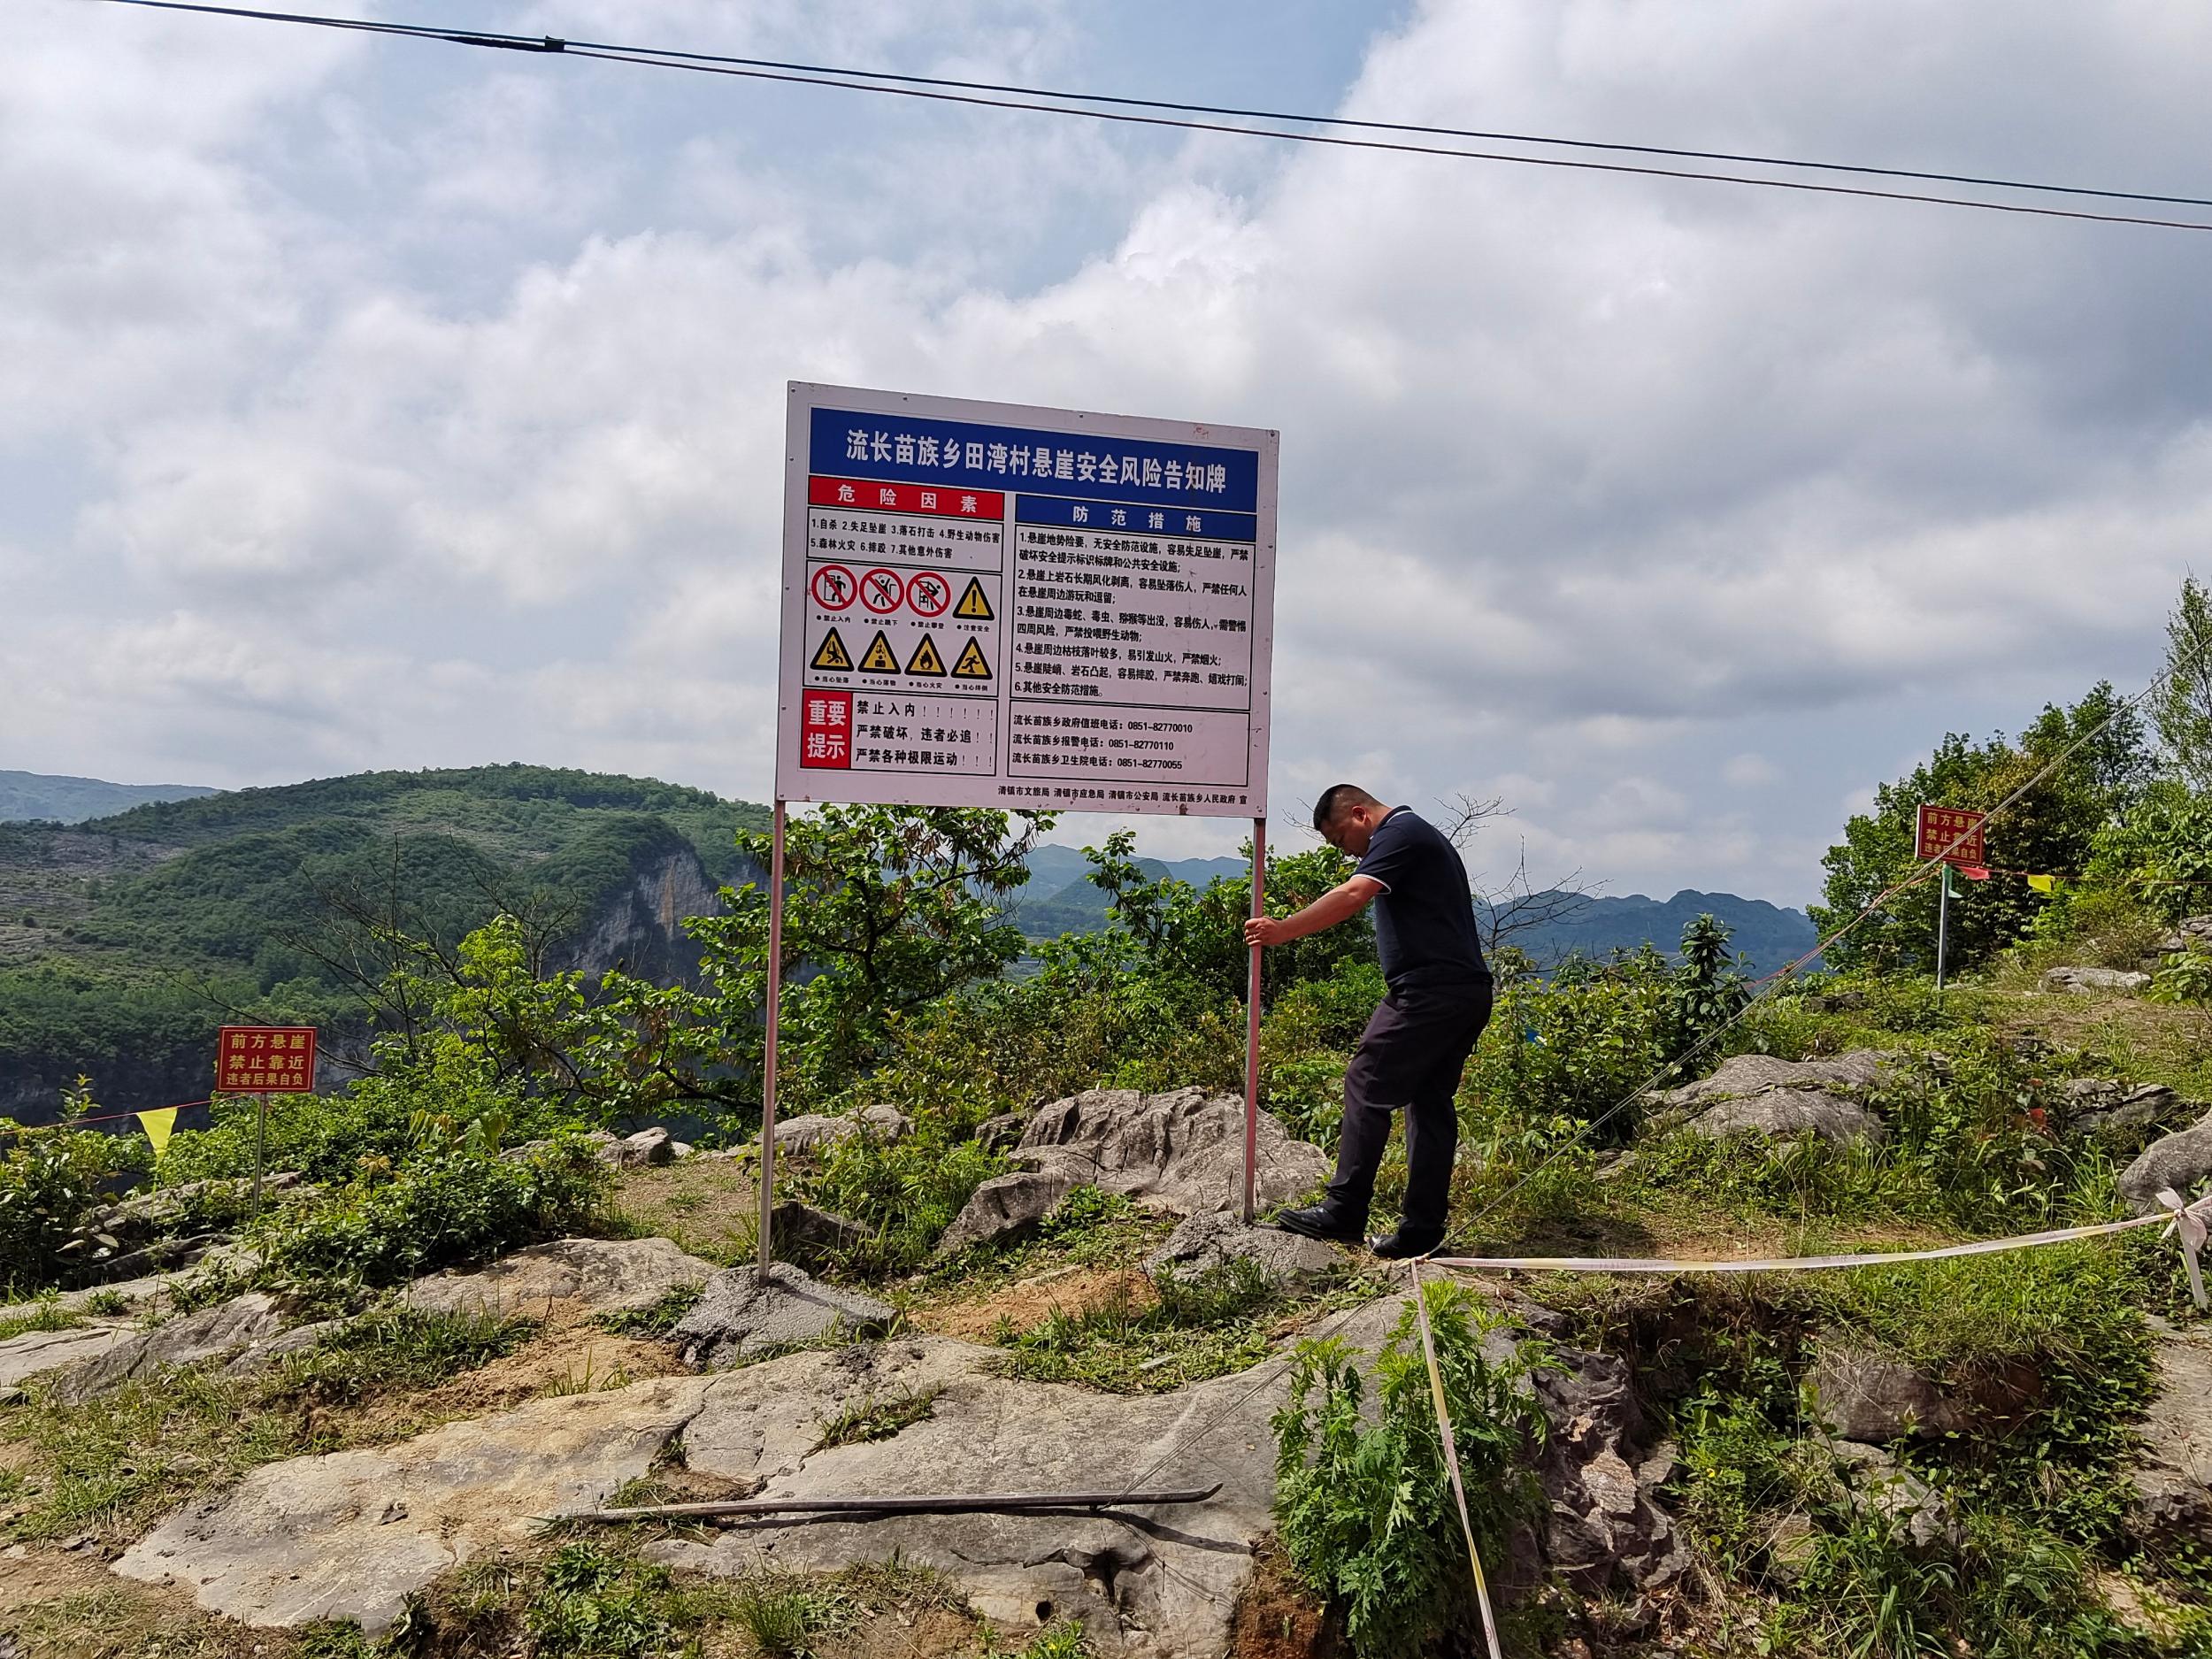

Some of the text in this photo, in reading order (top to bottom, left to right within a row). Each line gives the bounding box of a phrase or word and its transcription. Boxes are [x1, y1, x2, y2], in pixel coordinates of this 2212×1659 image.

[846, 428, 1226, 494] 流长苗族乡田湾村悬崖安全风险告知牌
[837, 484, 978, 513] 危险因素
[811, 518, 837, 530] 1.自杀
[1072, 506, 1202, 532] 防范措施
[810, 538, 856, 551] 5.森林火灾
[891, 544, 953, 559] 7.其他意外伤害
[808, 700, 847, 726] 重要
[807, 733, 845, 760] 提示
[230, 1033, 305, 1049] 前方悬崖
[228, 1055, 305, 1070] 禁止靠近
[226, 1072, 303, 1086] 违者后果自负
